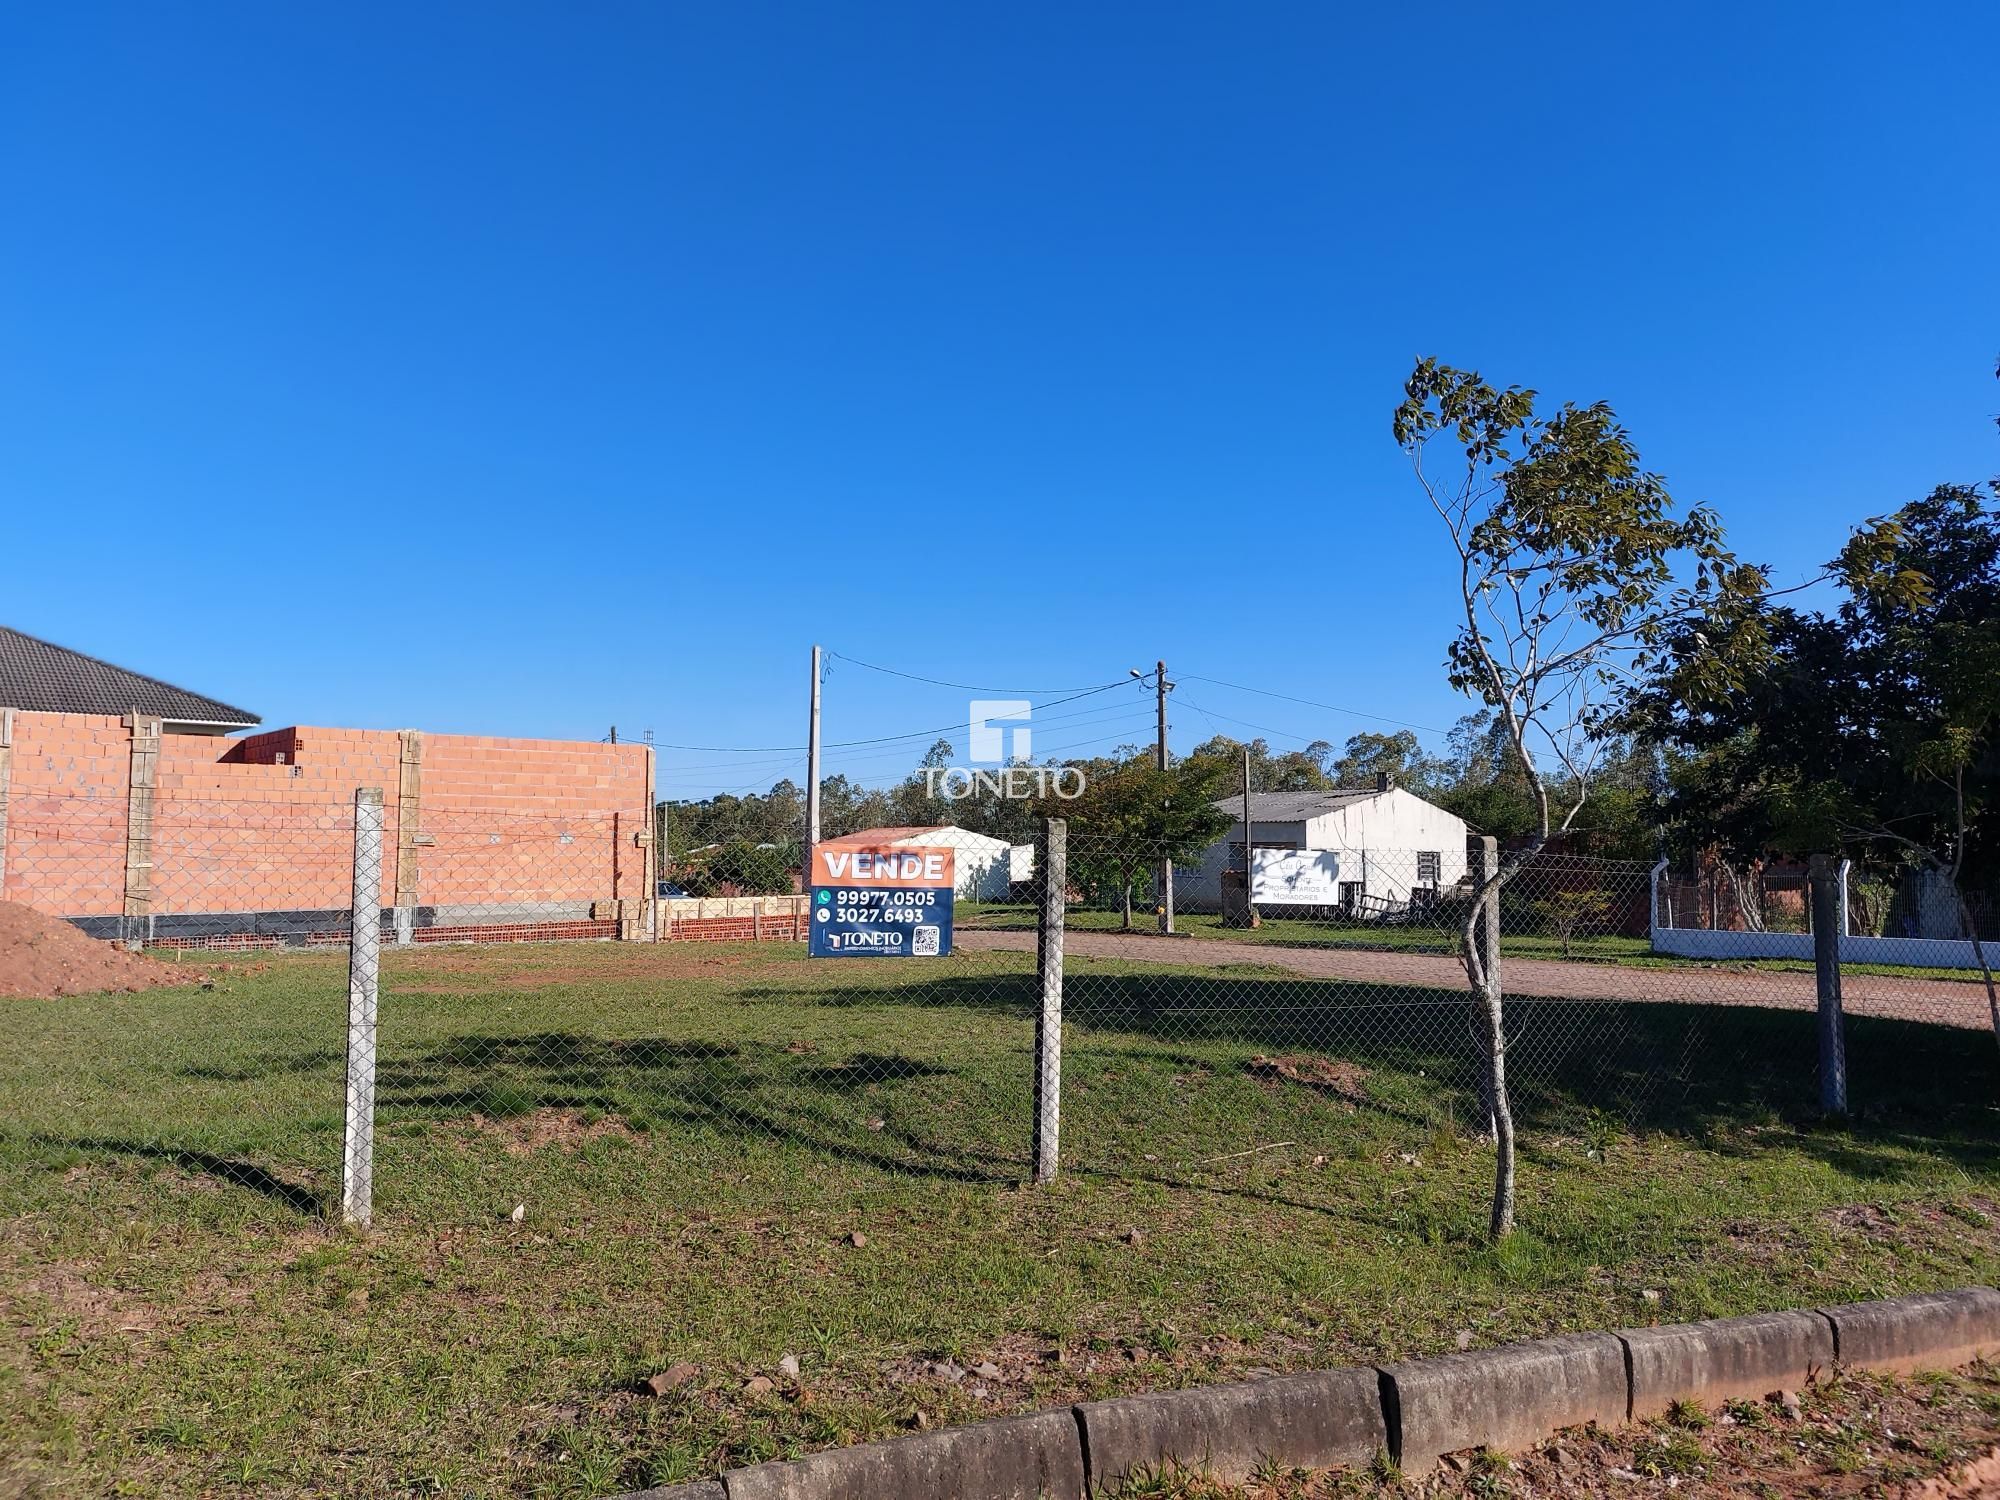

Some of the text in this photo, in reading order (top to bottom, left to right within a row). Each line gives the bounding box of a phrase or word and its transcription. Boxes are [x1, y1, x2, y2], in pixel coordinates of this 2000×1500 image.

[824, 852, 944, 880] VENDE
[837, 891, 935, 906] 99977.0505
[836, 908, 923, 923] 3027.6493
[841, 931, 903, 946] TONETO
